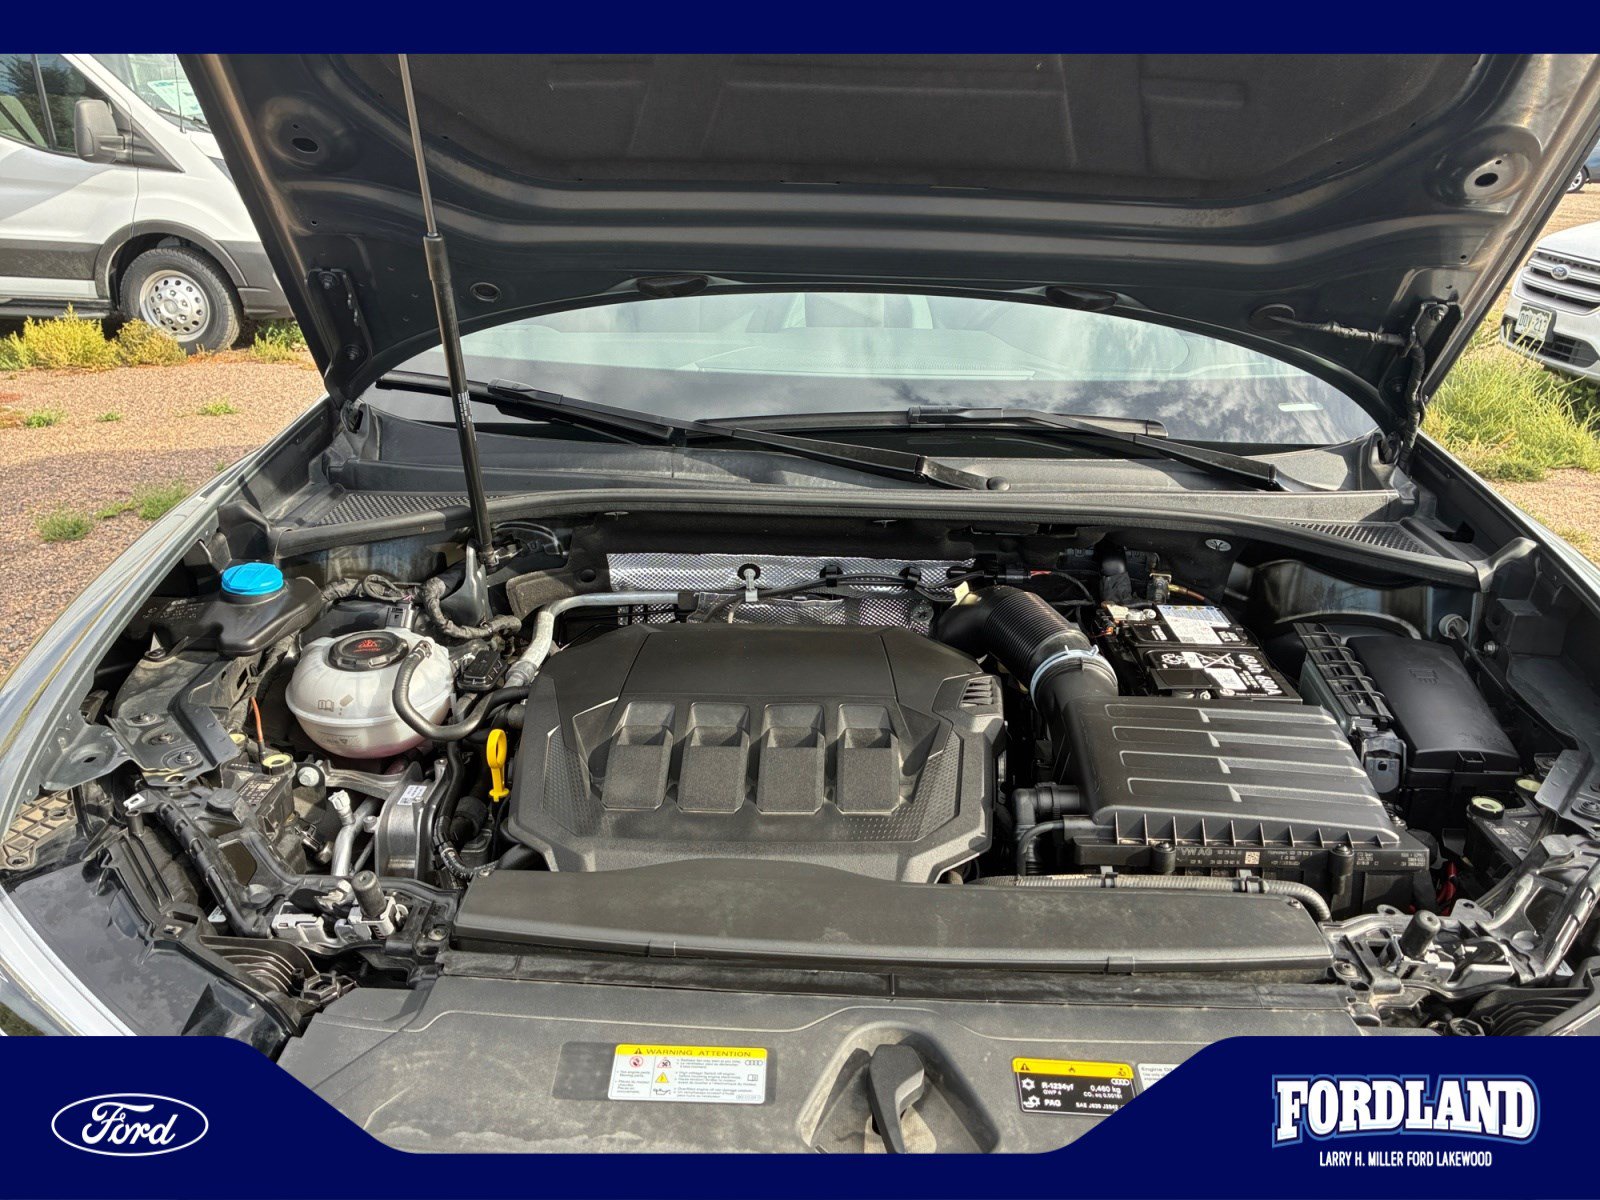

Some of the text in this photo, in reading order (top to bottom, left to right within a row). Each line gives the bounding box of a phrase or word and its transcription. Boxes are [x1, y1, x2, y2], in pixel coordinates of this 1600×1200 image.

[699, 1050, 752, 1058] ATTENTION
[1112, 1086, 1121, 1094] kg
[1044, 1099, 1061, 1107] PAG
